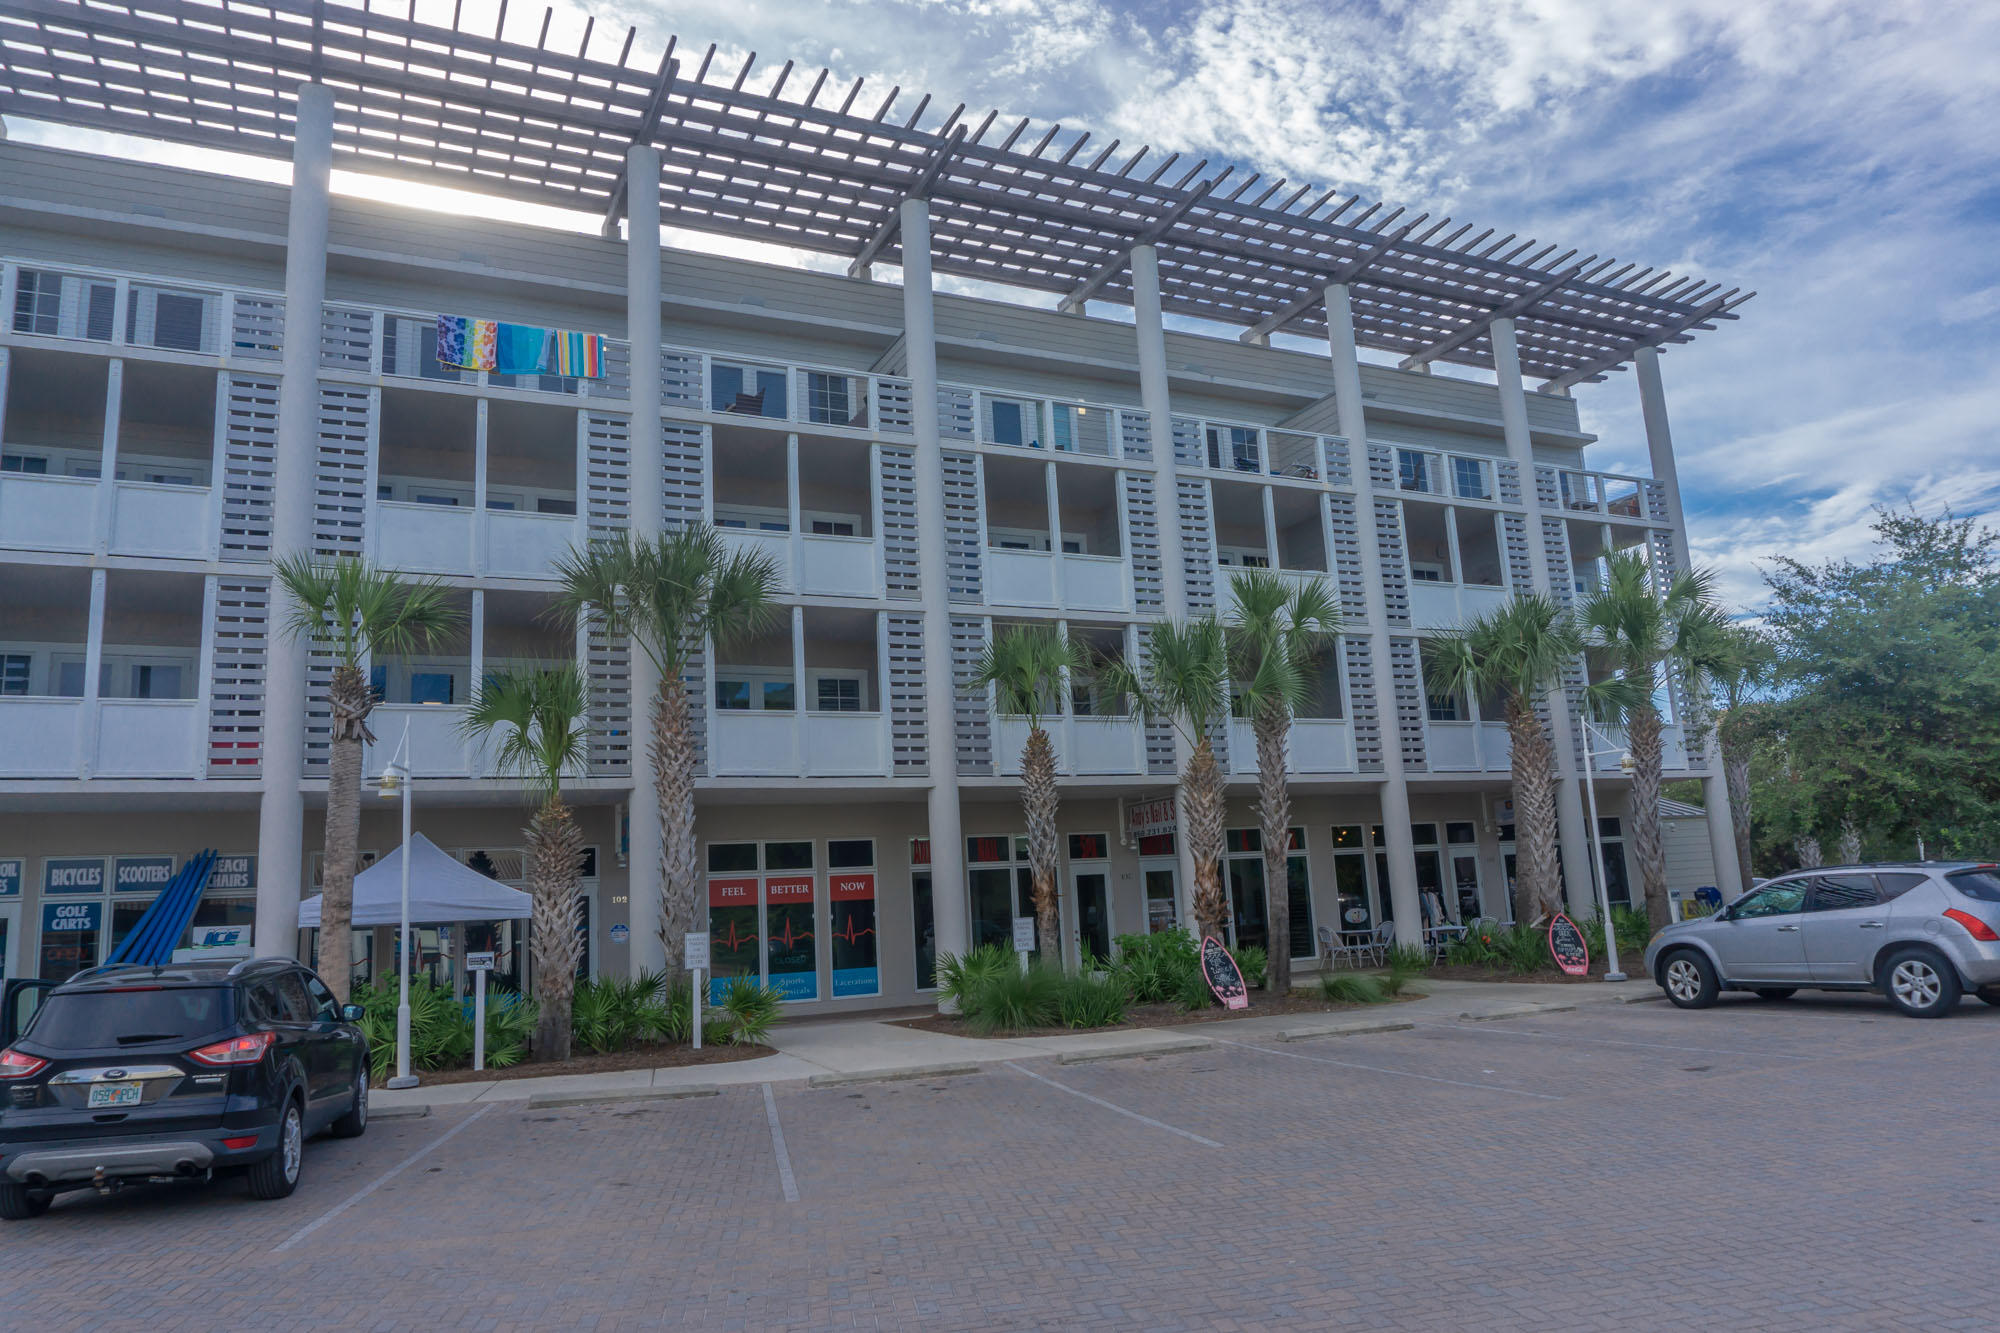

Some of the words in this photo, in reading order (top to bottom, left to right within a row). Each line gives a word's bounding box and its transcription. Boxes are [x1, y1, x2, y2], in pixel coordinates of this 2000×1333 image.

[51, 867, 101, 886] BICYCLES
[118, 865, 170, 883] SCOOTERS
[722, 887, 746, 896] FEEL
[771, 884, 809, 895] BETTER
[840, 882, 865, 892] NOW
[612, 895, 628, 904] 102
[56, 905, 89, 918] GOLF
[51, 917, 91, 930] CARTS
[203, 928, 241, 946] ICE
